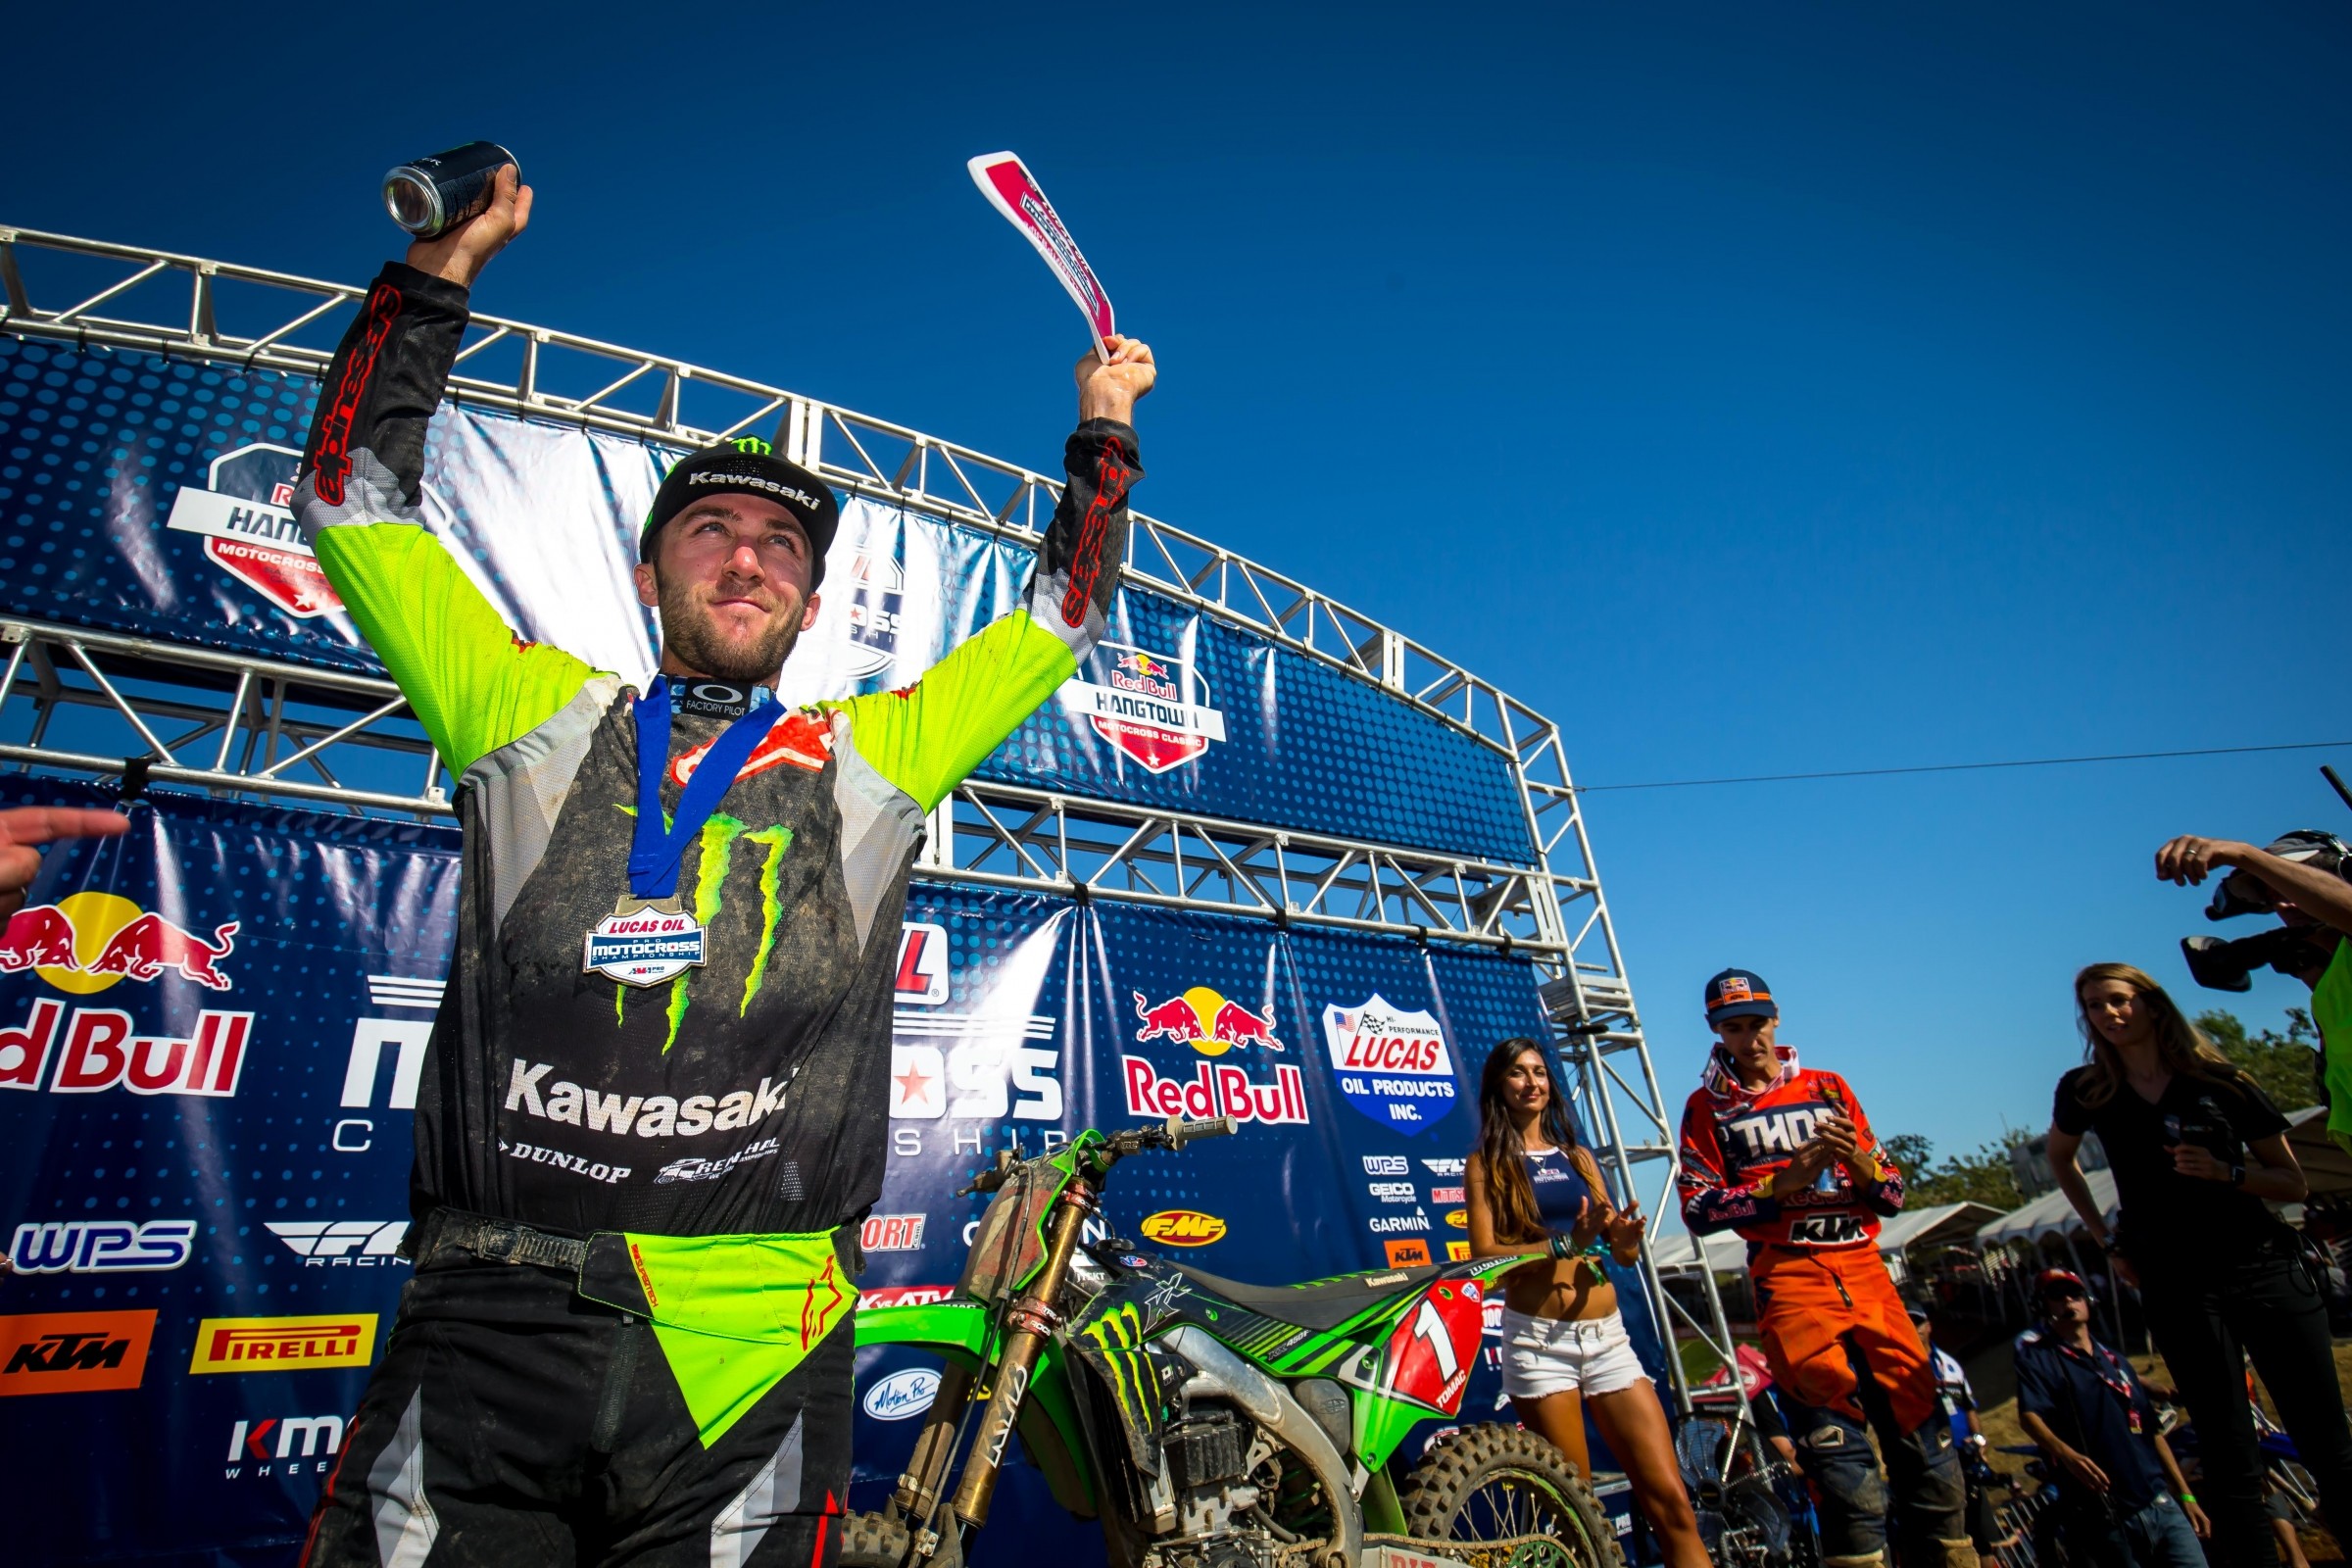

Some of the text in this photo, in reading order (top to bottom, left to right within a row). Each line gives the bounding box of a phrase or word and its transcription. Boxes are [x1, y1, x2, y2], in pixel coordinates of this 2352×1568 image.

[689, 471, 820, 510] Kawasaki
[1111, 670, 1177, 701] Red Bull
[686, 700, 745, 716] FACTORY PILOT
[1099, 720, 1159, 739] MOTOCROSS
[1161, 733, 1201, 748] CLASSIC
[609, 919, 685, 934] LUCAS OIL
[592, 941, 701, 956] MOTOCROSS
[592, 951, 701, 960] CHAMPIONSHIP
[1389, 1026, 1440, 1036] PERFORMANCE
[50, 1007, 255, 1097] Bull
[1345, 1036, 1440, 1071] LUCAS
[505, 1058, 800, 1138] Kawasak
[1123, 1056, 1216, 1120] Red
[1216, 1065, 1309, 1124] Bull
[1342, 1078, 1454, 1098] OIL PRODUCTS
[1389, 1103, 1422, 1120] INC.
[510, 1143, 631, 1184] DUNLOP
[695, 1138, 780, 1174] RENHAL
[1362, 1155, 1409, 1175] WPS
[1369, 1183, 1414, 1196] GEICO
[264, 1221, 411, 1255] FL
[1143, 1215, 1224, 1237] FMF
[1369, 1217, 1431, 1232] GARMIN
[1789, 1211, 1869, 1245] KTM
[13, 1220, 196, 1274] WPS
[1395, 1248, 1424, 1262] KTM
[305, 1257, 411, 1267] RACIN
[1364, 1272, 1409, 1288] Kawasaki
[857, 1294, 882, 1310] X
[3, 1325, 362, 1374] KTM PIRELLI
[1413, 1298, 1458, 1385] 1
[874, 1377, 935, 1411] Motion Pro
[1436, 1370, 1467, 1408] TOMAC
[227, 1415, 345, 1462] KM
[225, 1461, 327, 1480] WHEE
